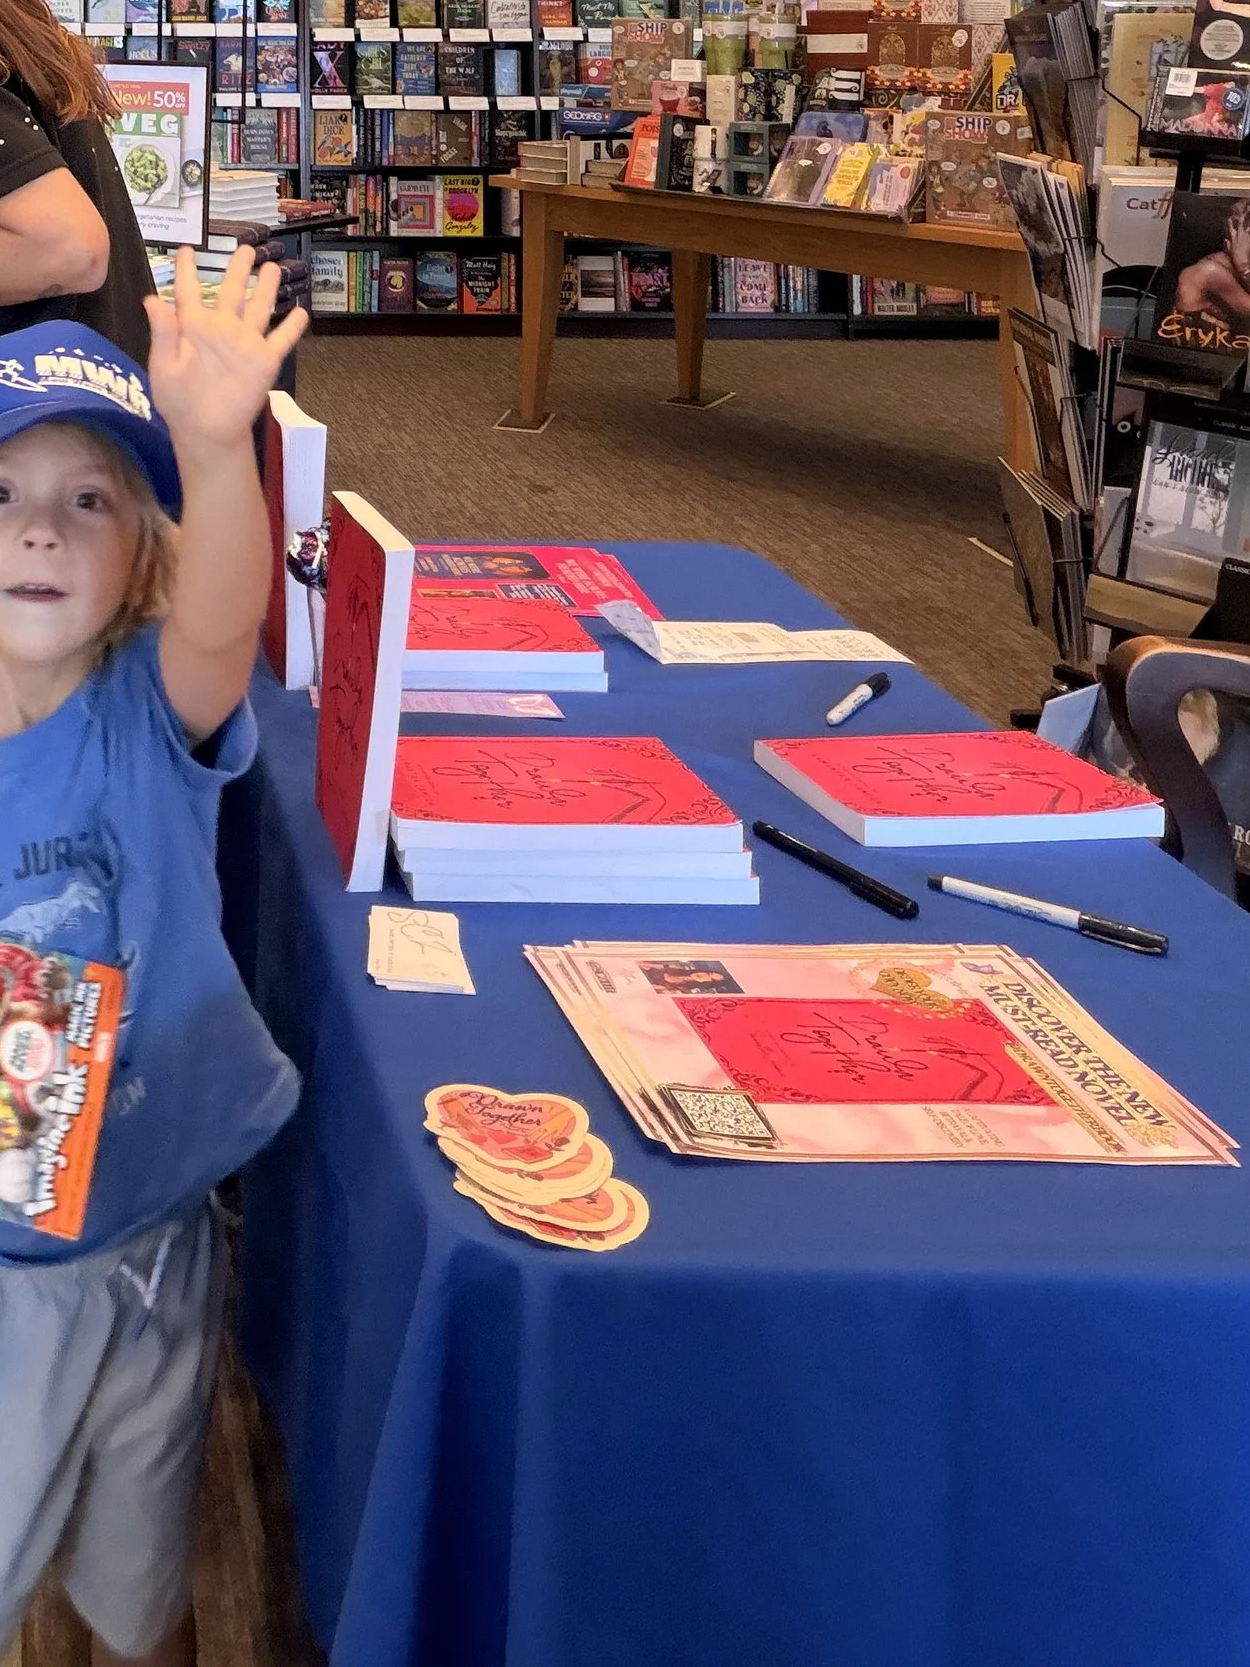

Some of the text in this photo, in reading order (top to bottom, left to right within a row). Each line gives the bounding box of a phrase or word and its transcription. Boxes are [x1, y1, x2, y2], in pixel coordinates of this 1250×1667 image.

[637, 22, 669, 33] SHIP
[444, 46, 475, 54] CHILDREN
[313, 51, 347, 87] X
[153, 90, 186, 108] 50%
[563, 110, 602, 121] GEOMAG
[956, 117, 992, 129] SHIP
[738, 264, 769, 272] LEAVE
[741, 296, 768, 304] BACK
[1158, 312, 1250, 350] Eryka
[981, 984, 1081, 1076] MUST-READ
[1068, 1071, 1138, 1128] NOVEL
[1002, 981, 1176, 1130] DISCOVER THE NEW
[46, 1062, 89, 1116] Ink
[459, 1091, 544, 1115] Drawn
[465, 1105, 543, 1128] Together
